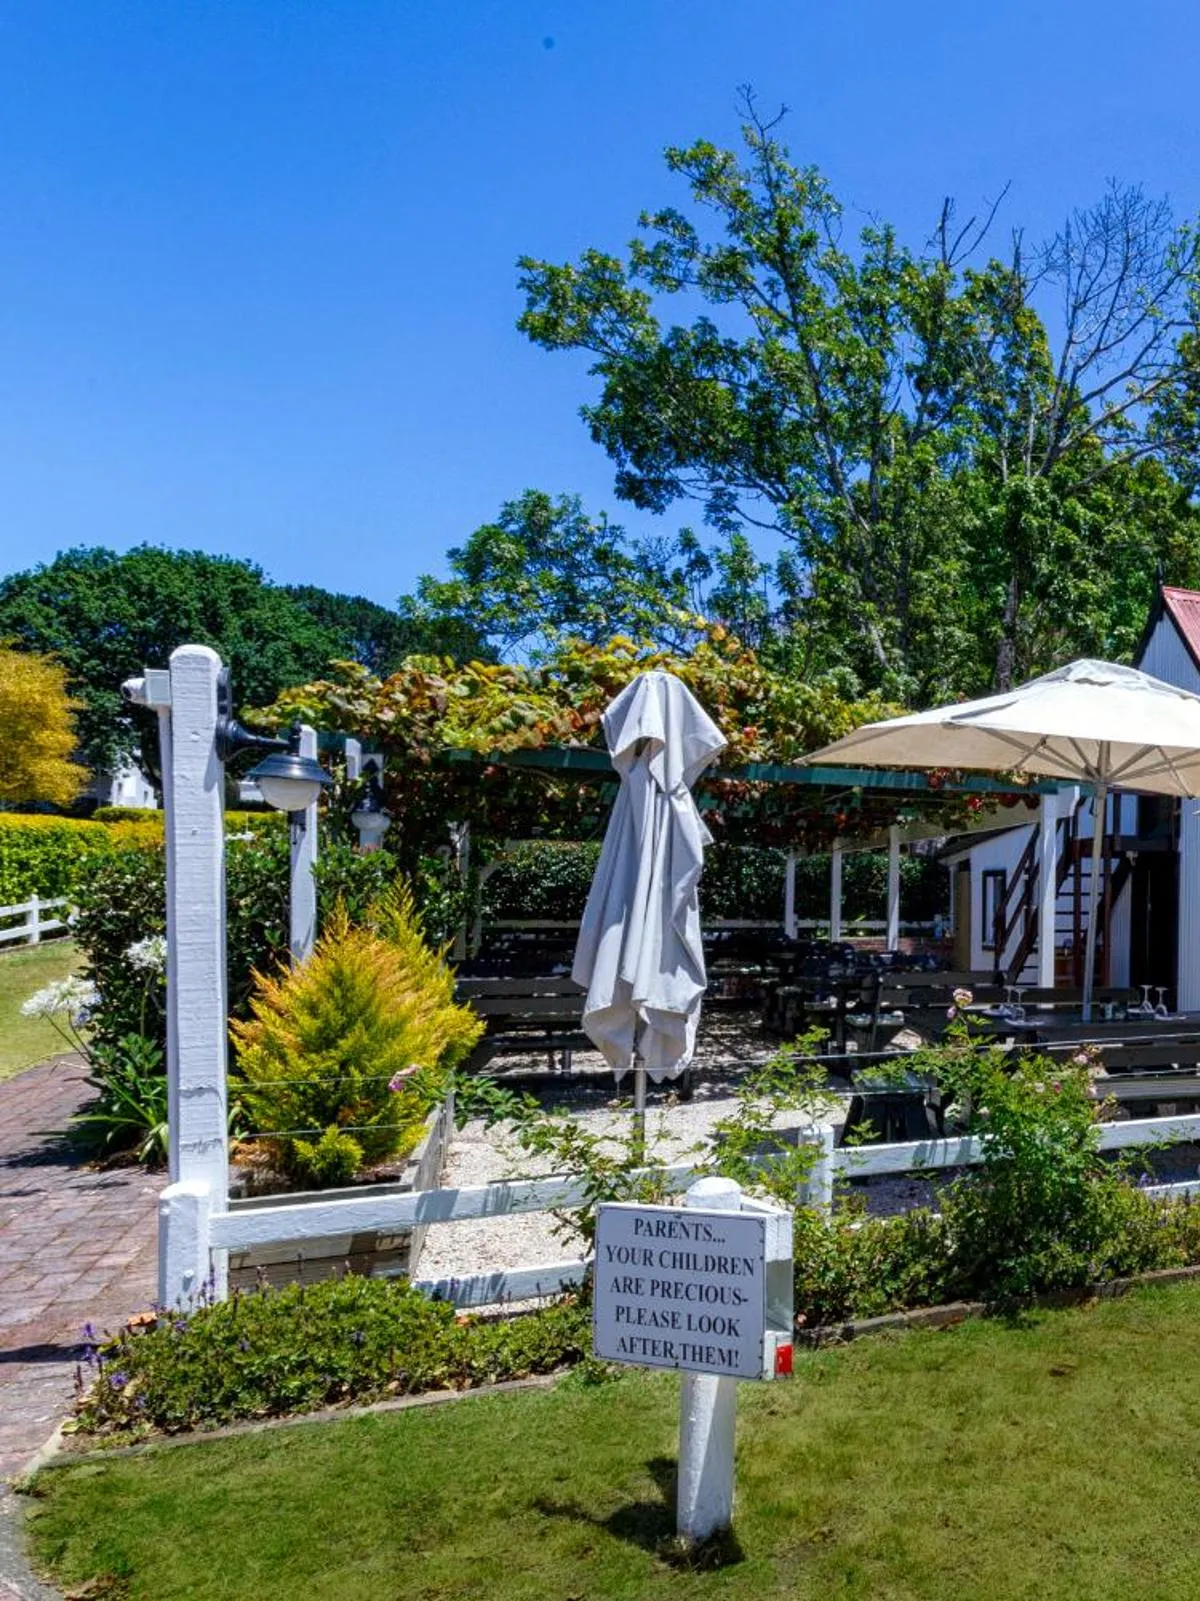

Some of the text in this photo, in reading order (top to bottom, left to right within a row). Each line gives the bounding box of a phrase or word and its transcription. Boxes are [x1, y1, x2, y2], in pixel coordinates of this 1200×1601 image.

[634, 1218, 726, 1244] PARENTS...
[606, 1245, 755, 1276] YOUR CHILDREN
[610, 1276, 749, 1306] ARE PRECIOUS-
[615, 1305, 741, 1337] PLEASE LOOK
[617, 1336, 740, 1368] AFTER THEM!
